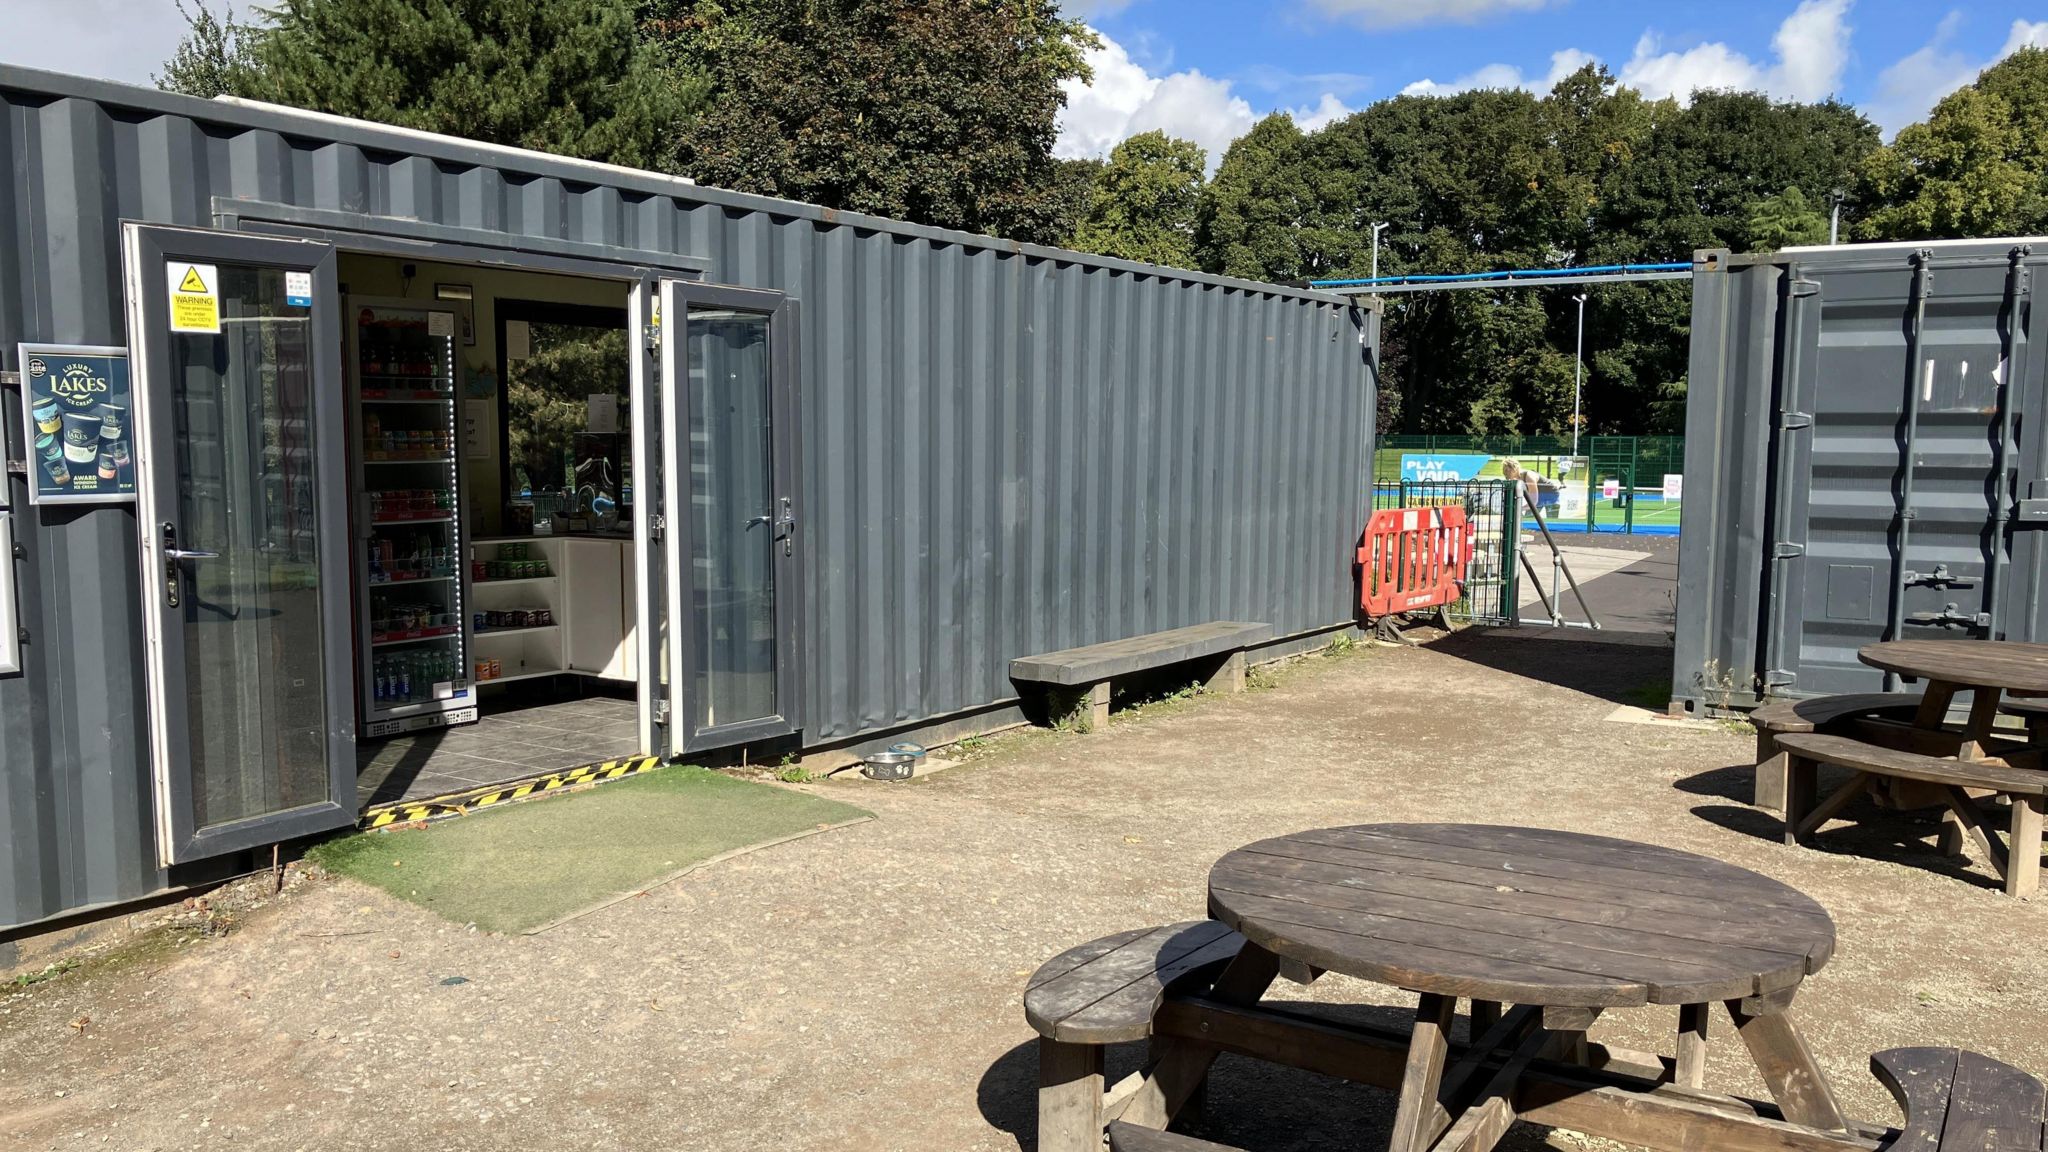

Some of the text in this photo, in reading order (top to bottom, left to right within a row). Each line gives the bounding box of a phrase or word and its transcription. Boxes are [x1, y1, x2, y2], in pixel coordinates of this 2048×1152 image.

[176, 296, 213, 305] WARNING
[62, 363, 93, 374] LUXURY
[49, 374, 107, 396] LAKES
[75, 397, 94, 407] CREAM
[1406, 461, 1446, 470] PLAY
